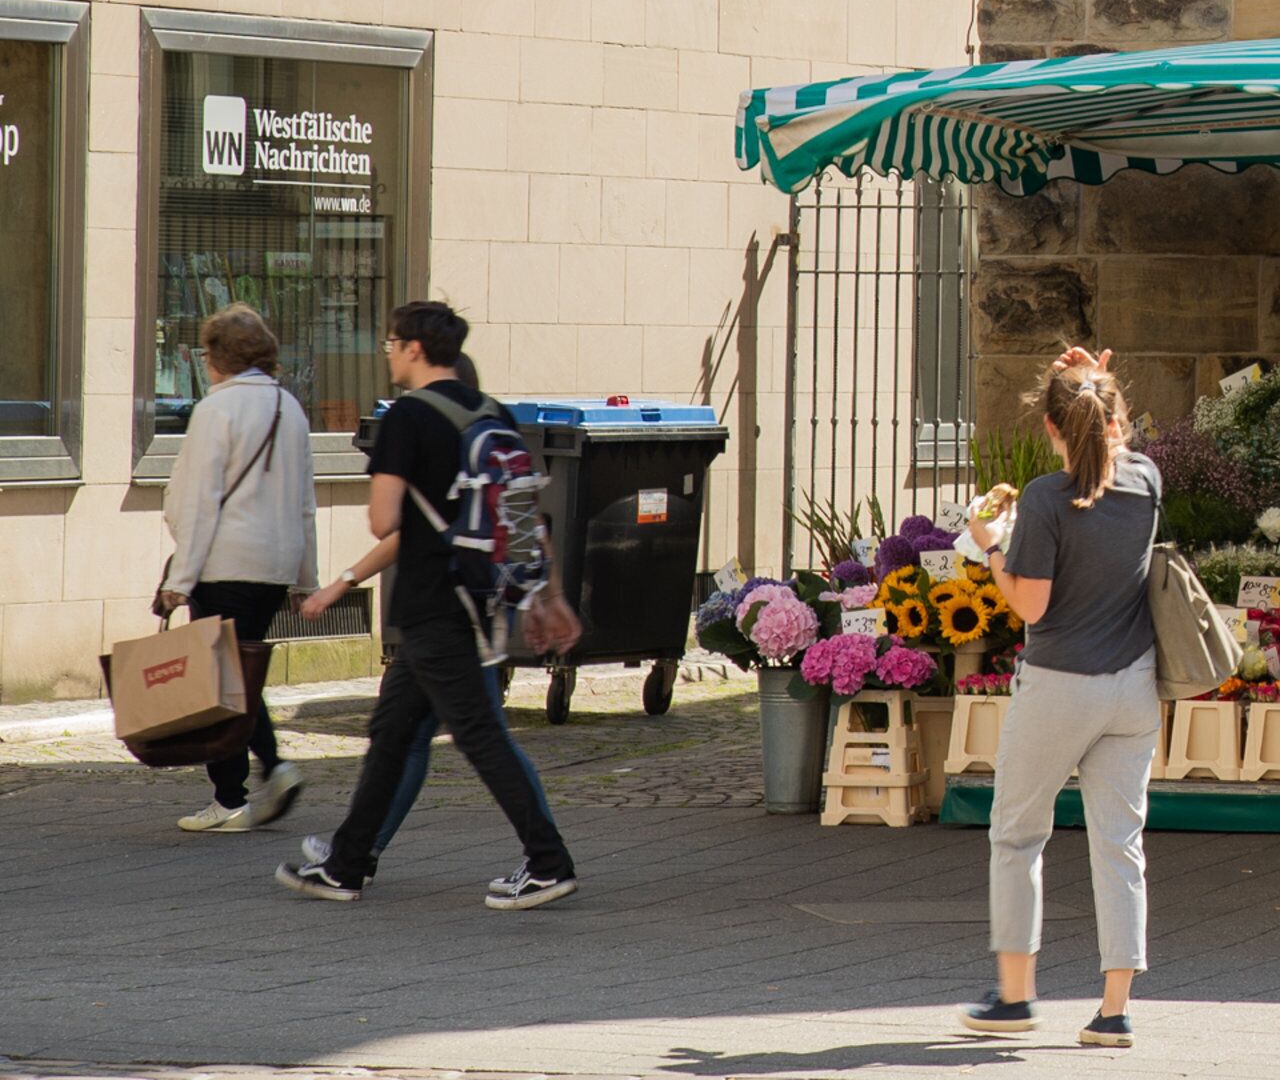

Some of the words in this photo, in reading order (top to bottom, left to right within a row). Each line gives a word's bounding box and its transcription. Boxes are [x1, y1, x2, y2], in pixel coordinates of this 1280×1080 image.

[253, 108, 372, 144] Westfälische
[206, 130, 243, 166] WN
[254, 141, 371, 176] Nachrichten
[314, 194, 371, 213] www.wn.de
